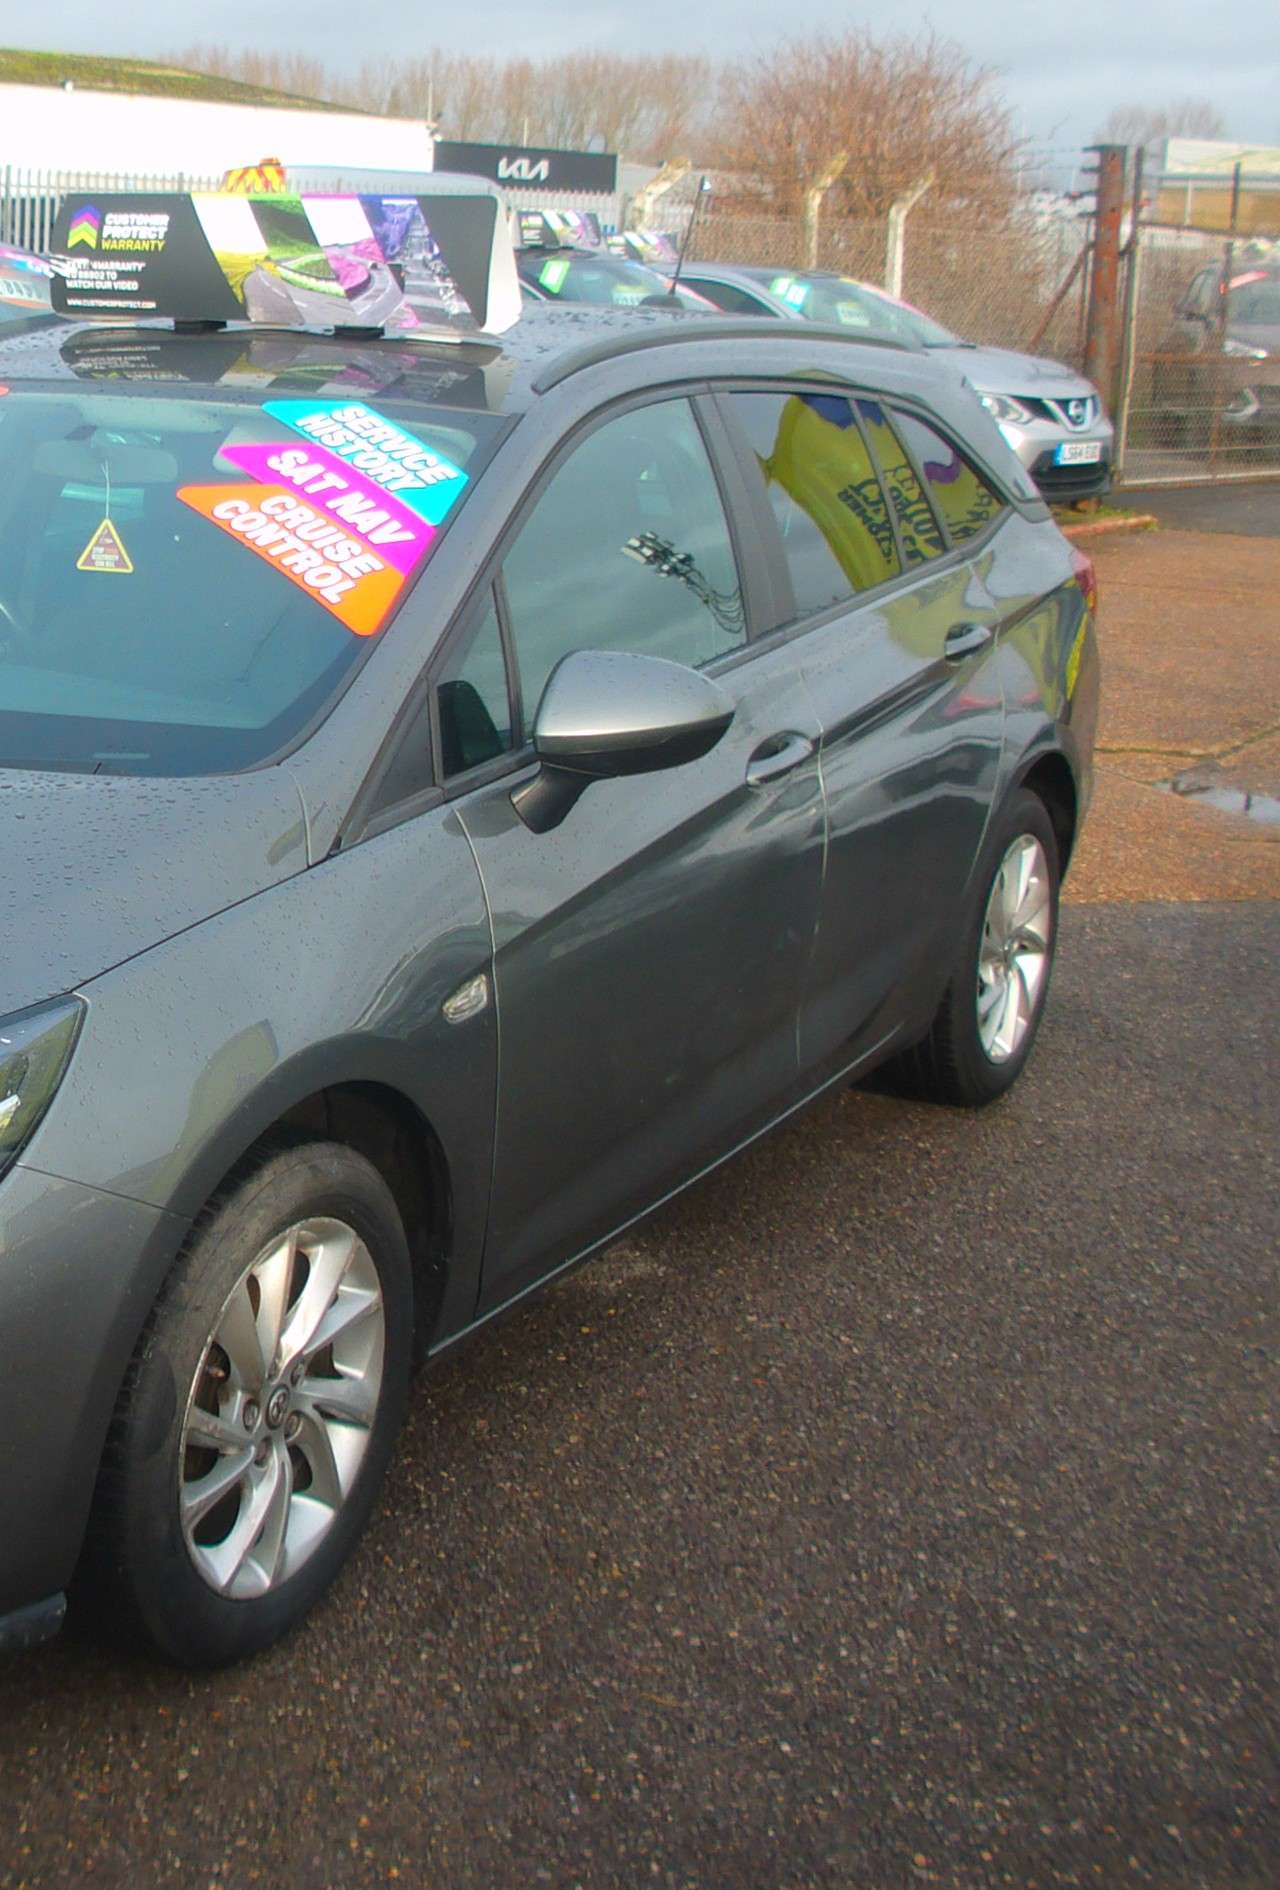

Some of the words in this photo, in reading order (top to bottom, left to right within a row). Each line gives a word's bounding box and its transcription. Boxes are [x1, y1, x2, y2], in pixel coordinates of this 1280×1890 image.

[497, 156, 550, 181] KIA
[105, 212, 169, 226] CUSTOMER
[102, 225, 168, 239] PROTECT
[101, 239, 166, 251] WARRANTY
[66, 279, 93, 289] WATCH
[95, 280, 113, 290] OUR
[114, 280, 138, 291] VIDEO
[106, 270, 117, 281] TO
[295, 412, 427, 492] HISTORY
[330, 405, 459, 485] SERVICE
[266, 449, 349, 494] SAT
[325, 491, 416, 545] NAV
[260, 494, 384, 579] CRUISE
[212, 499, 356, 605] CONTROL
